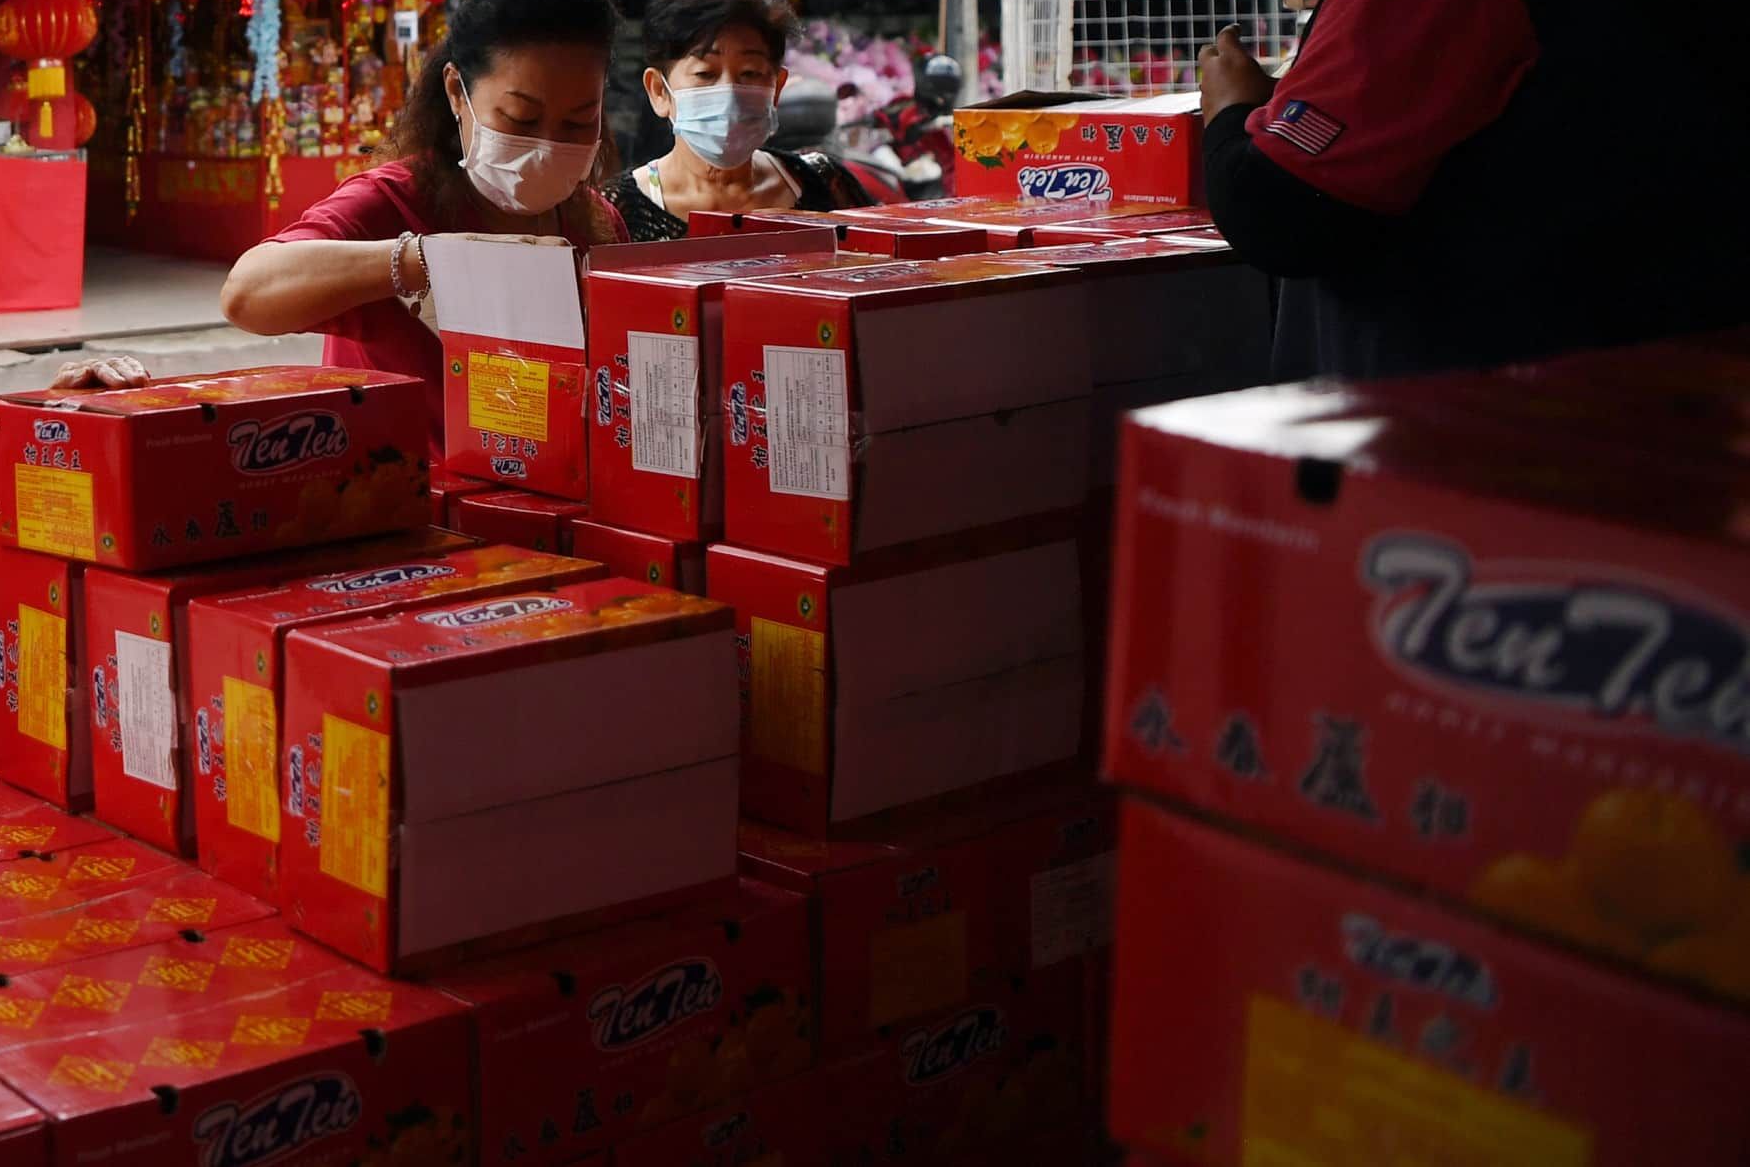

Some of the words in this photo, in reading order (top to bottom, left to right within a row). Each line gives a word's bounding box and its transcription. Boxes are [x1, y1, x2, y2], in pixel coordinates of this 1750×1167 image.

[229, 420, 291, 468] Ten
[288, 413, 346, 459] Ten
[1367, 537, 1567, 685] Ten
